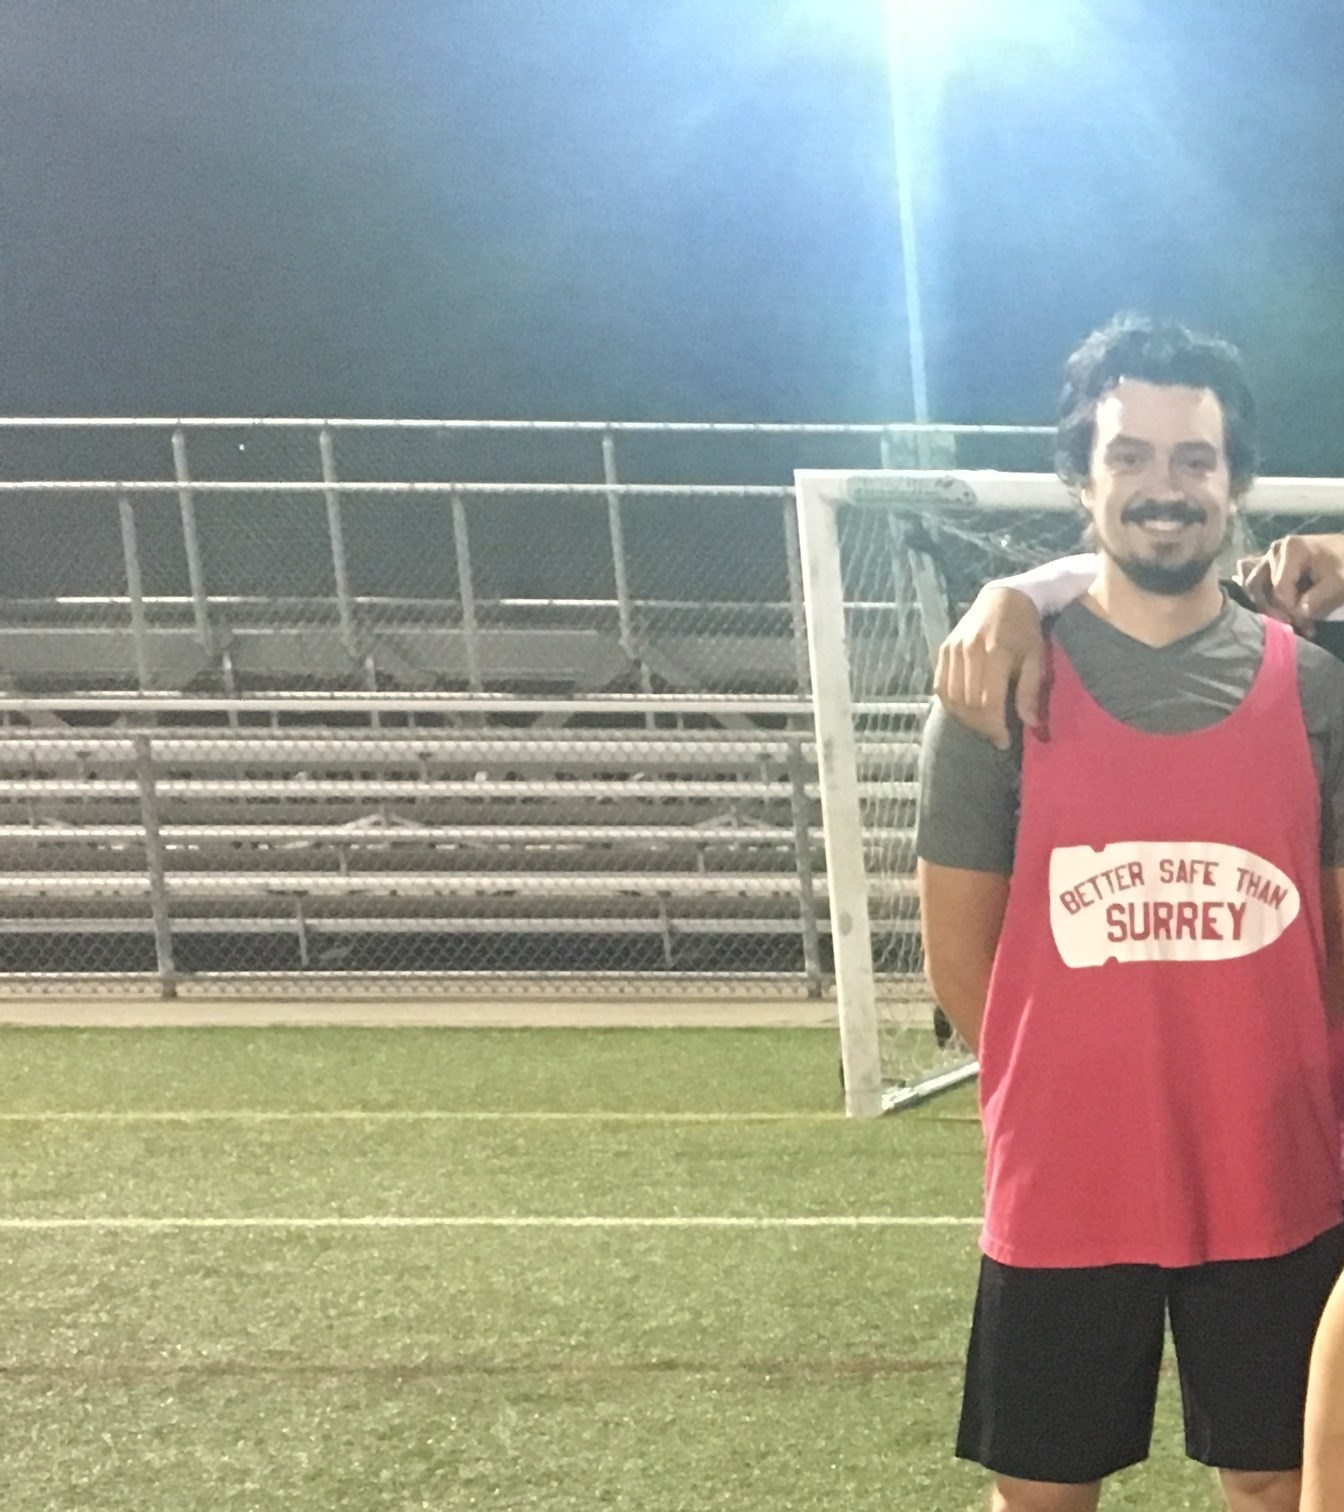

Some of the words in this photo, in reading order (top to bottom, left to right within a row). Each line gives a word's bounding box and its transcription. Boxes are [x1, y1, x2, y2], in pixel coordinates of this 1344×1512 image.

[1060, 861, 1144, 915] BETTER
[1160, 859, 1220, 886] SAFE
[1236, 867, 1288, 910] THAN
[1106, 901, 1247, 942] SURREY
